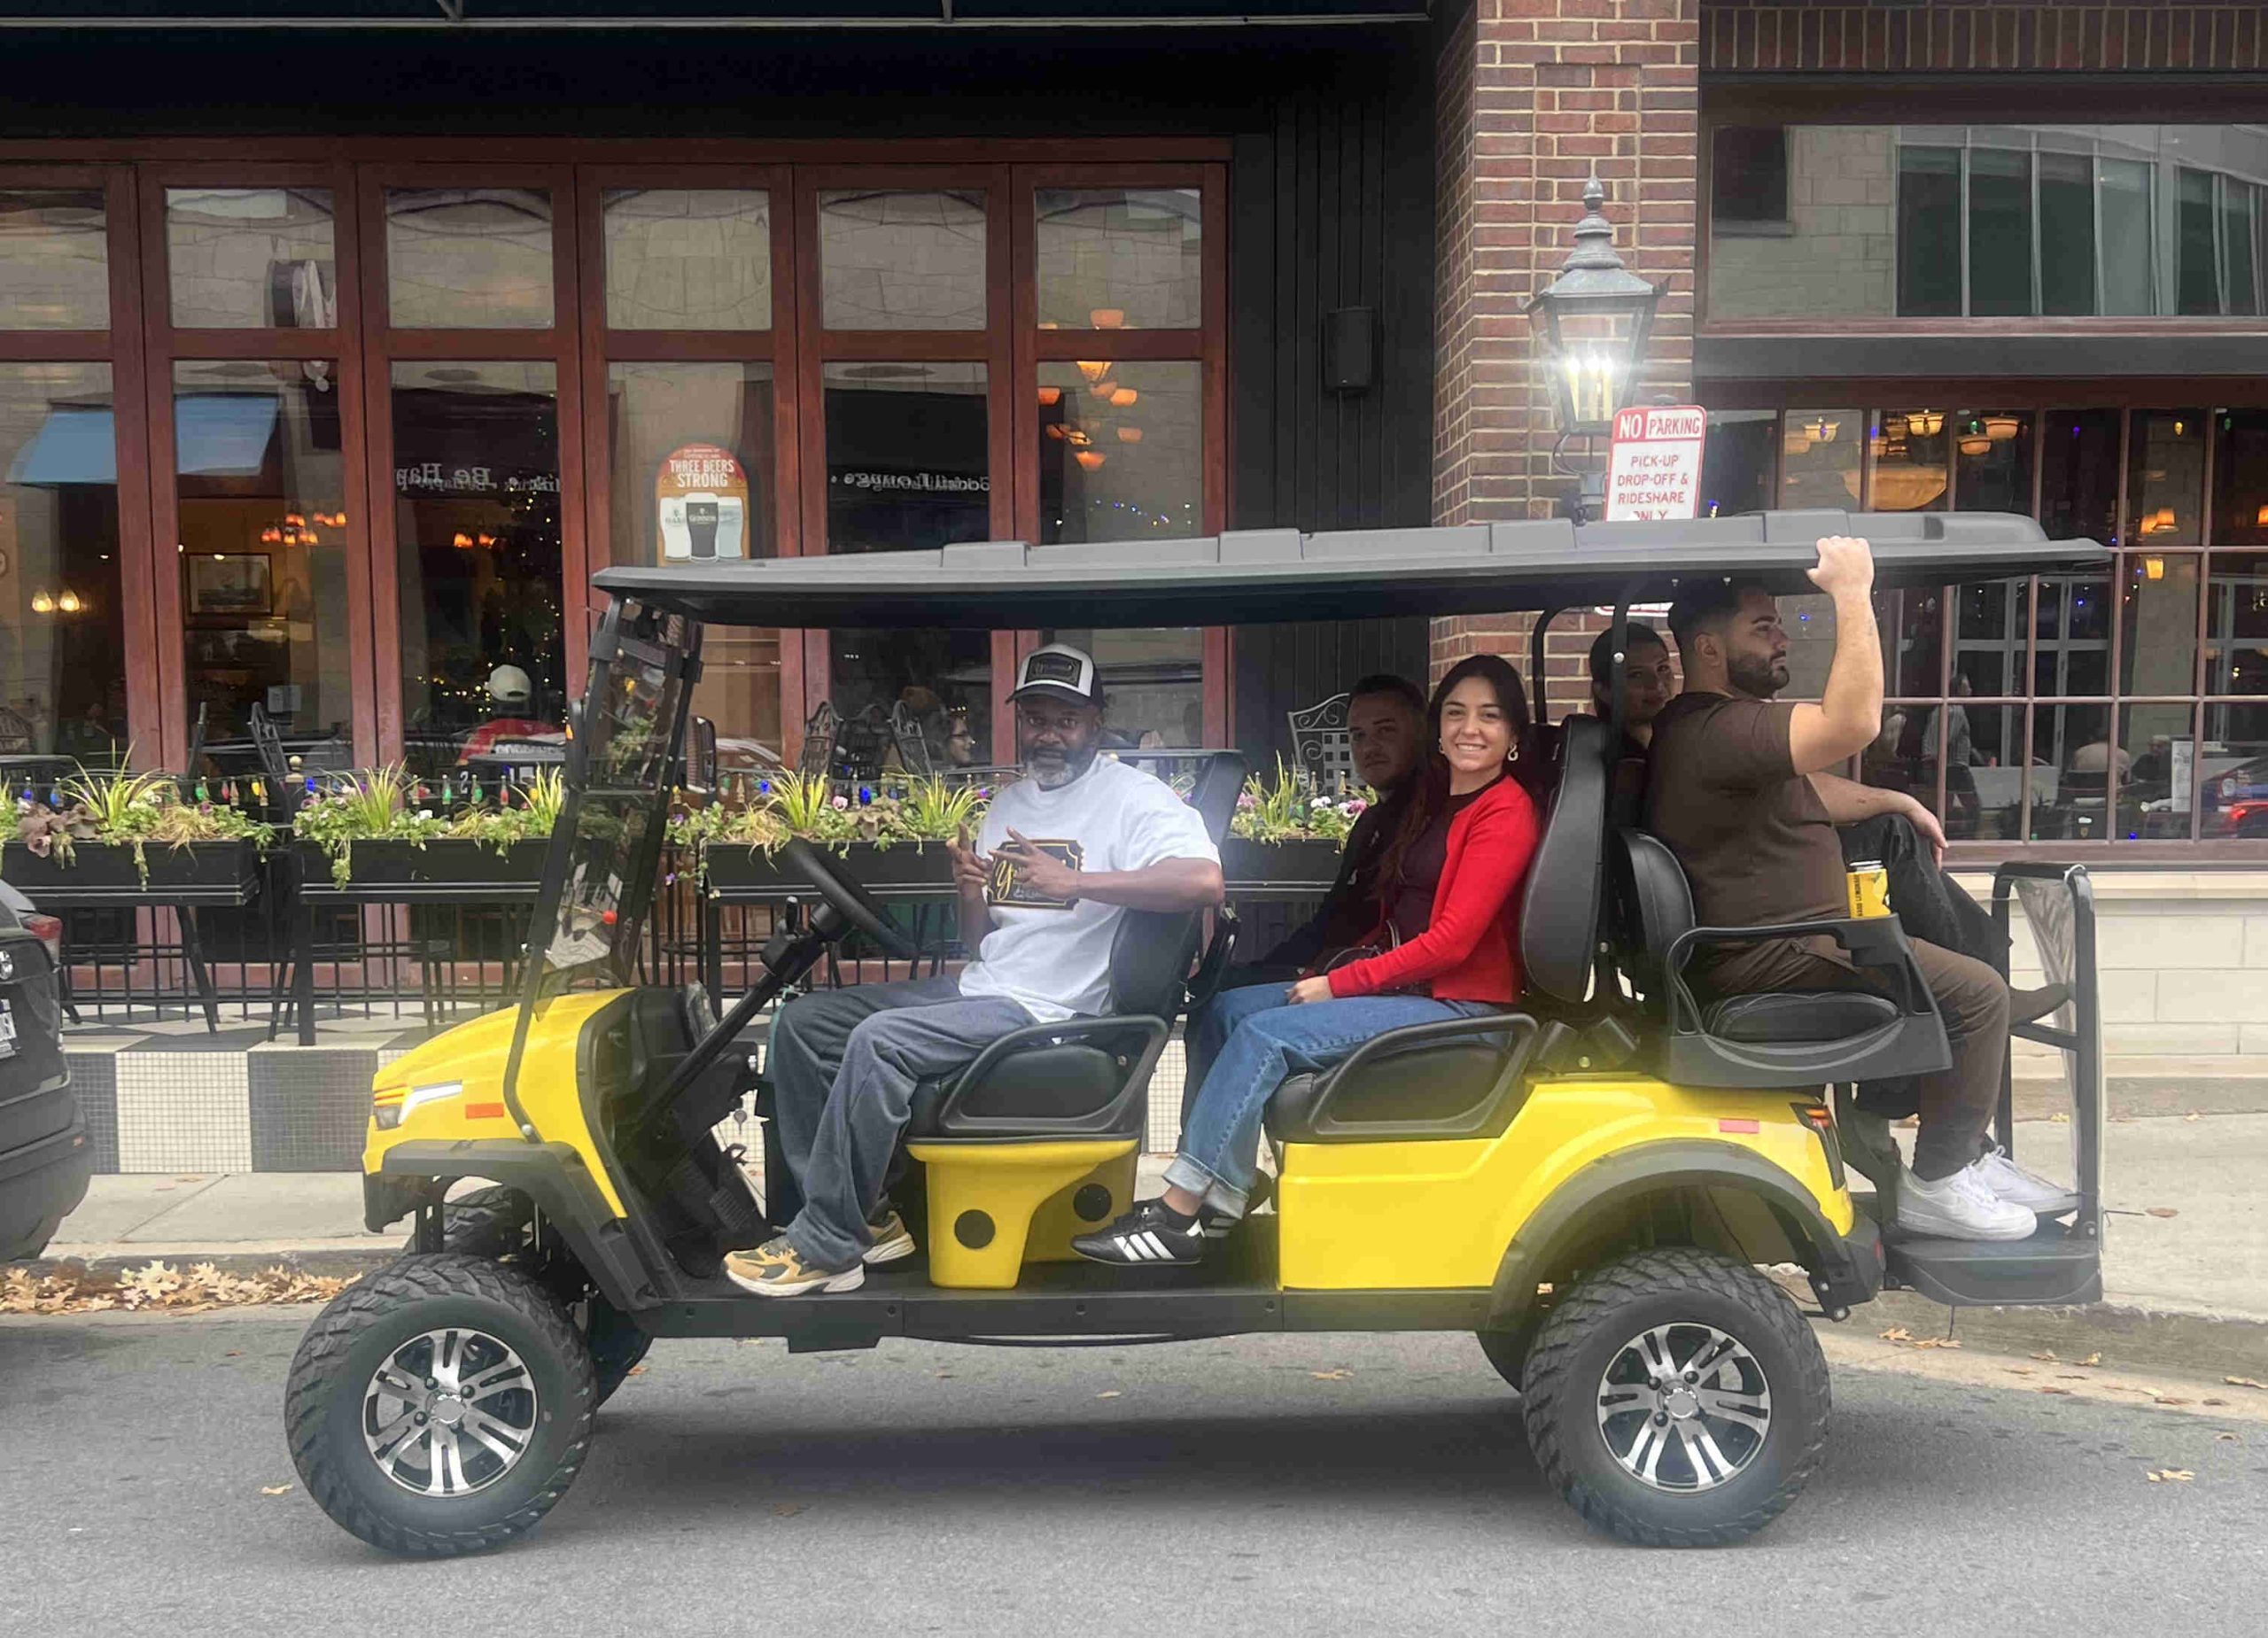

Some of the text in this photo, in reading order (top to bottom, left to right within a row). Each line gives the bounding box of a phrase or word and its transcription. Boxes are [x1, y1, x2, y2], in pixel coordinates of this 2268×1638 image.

[1619, 414, 1701, 439] NO PARKING
[669, 459, 735, 473] THREE BEERS
[1630, 454, 1680, 468] PICK-UP
[677, 473, 728, 488] STRONG
[1617, 473, 1677, 486] DROP-OFF
[1617, 491, 1685, 505] RIDESHARE
